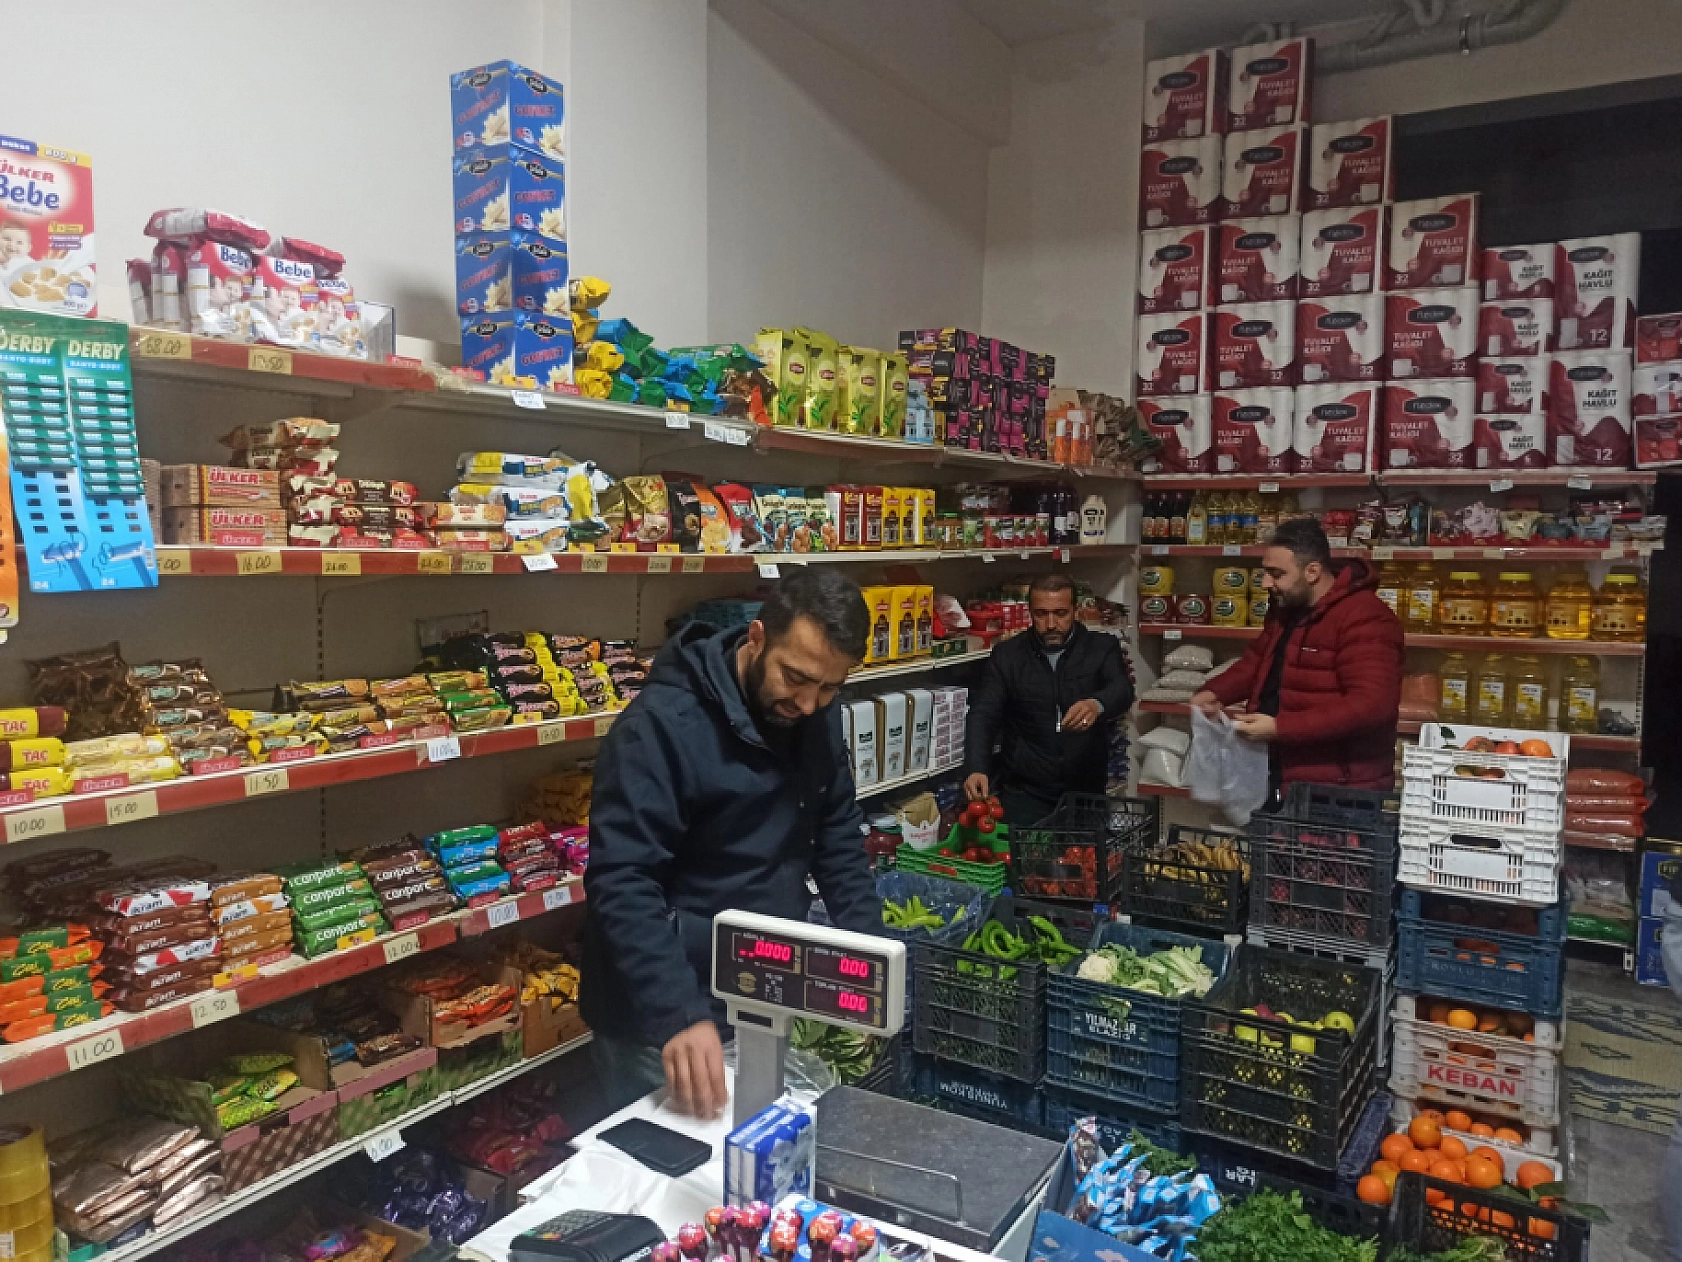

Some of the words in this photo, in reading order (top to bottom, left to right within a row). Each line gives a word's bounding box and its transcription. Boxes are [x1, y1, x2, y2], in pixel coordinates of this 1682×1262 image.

[274, 260, 311, 279] Bebe
[1589, 328, 1608, 342] 12
[68, 340, 125, 361] DERBY
[1594, 447, 1613, 461] 12
[209, 466, 260, 486] ÜLKER
[211, 509, 266, 527] ÜLKER
[1427, 1064, 1516, 1096] KEBAN
